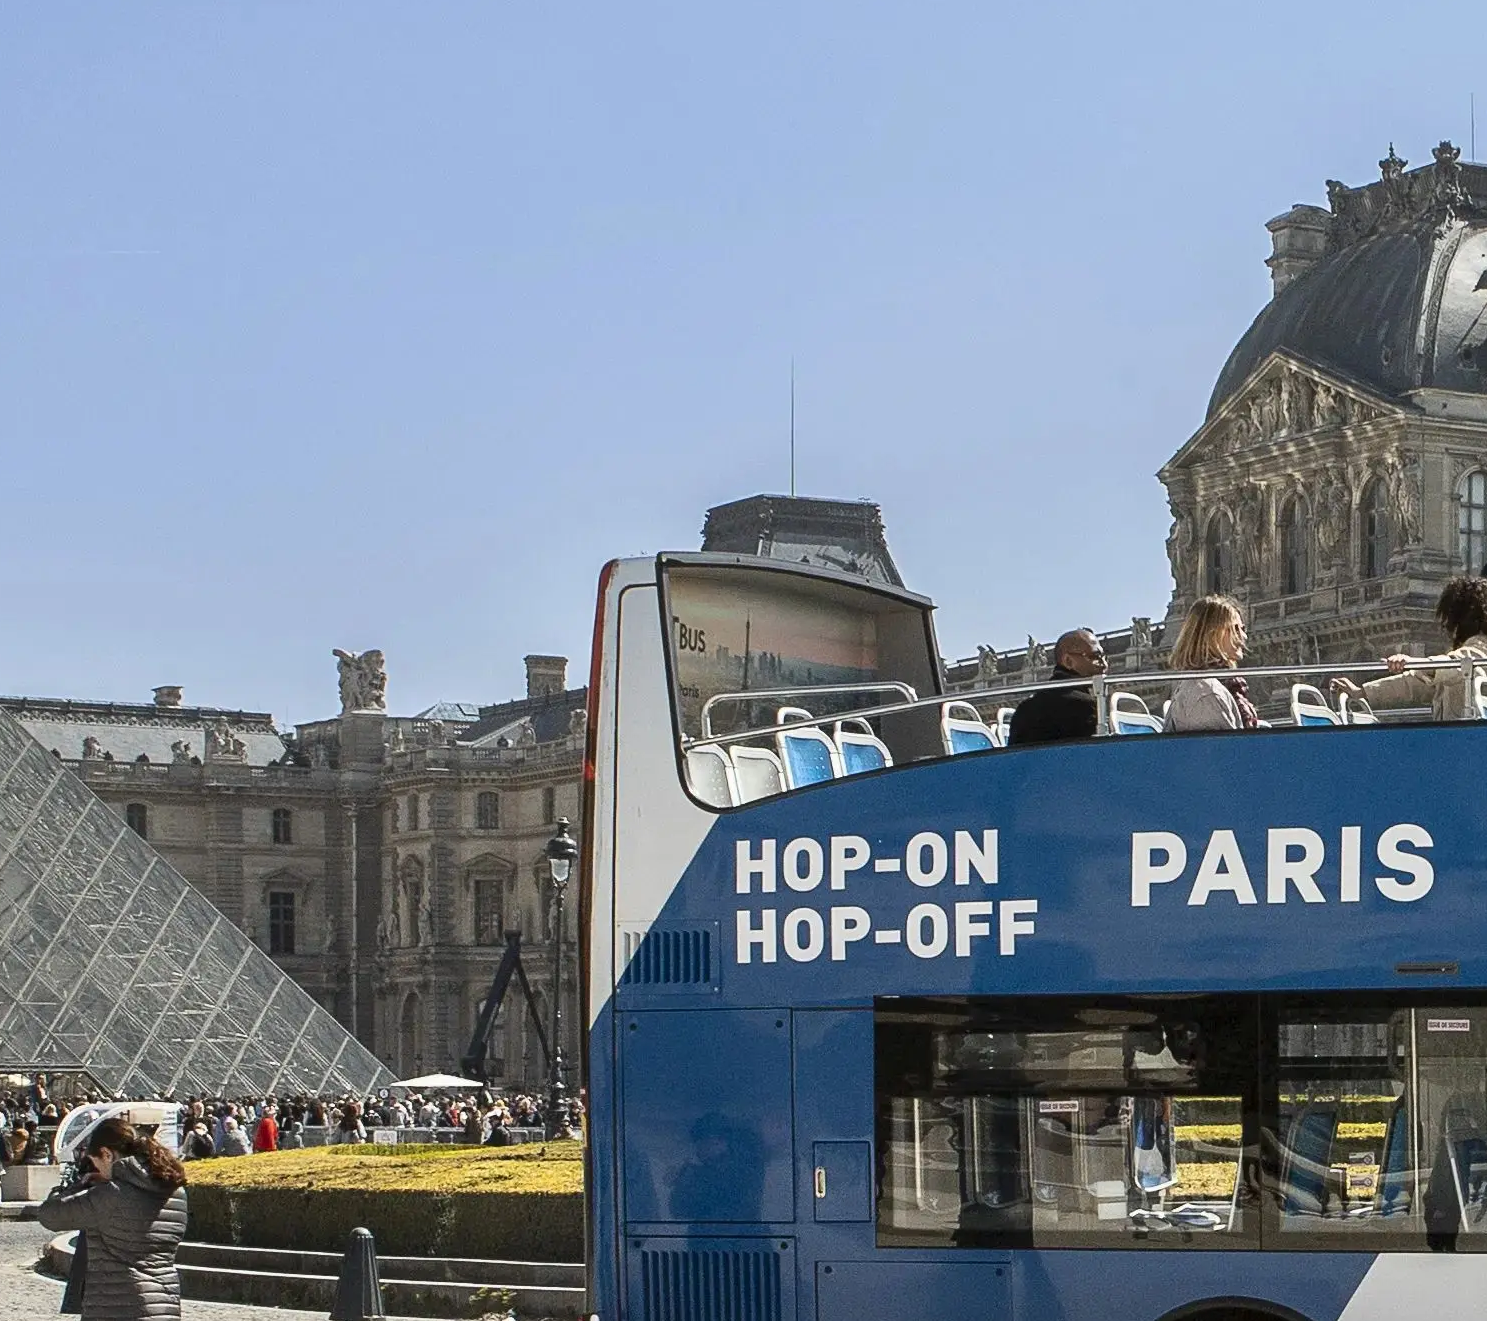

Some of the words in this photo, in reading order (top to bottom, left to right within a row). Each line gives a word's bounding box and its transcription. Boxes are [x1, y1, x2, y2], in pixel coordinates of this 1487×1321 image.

[734, 828, 1000, 895] HOP-ON
[1130, 822, 1436, 907] PARIS
[735, 898, 1040, 965] HOP-OFF
